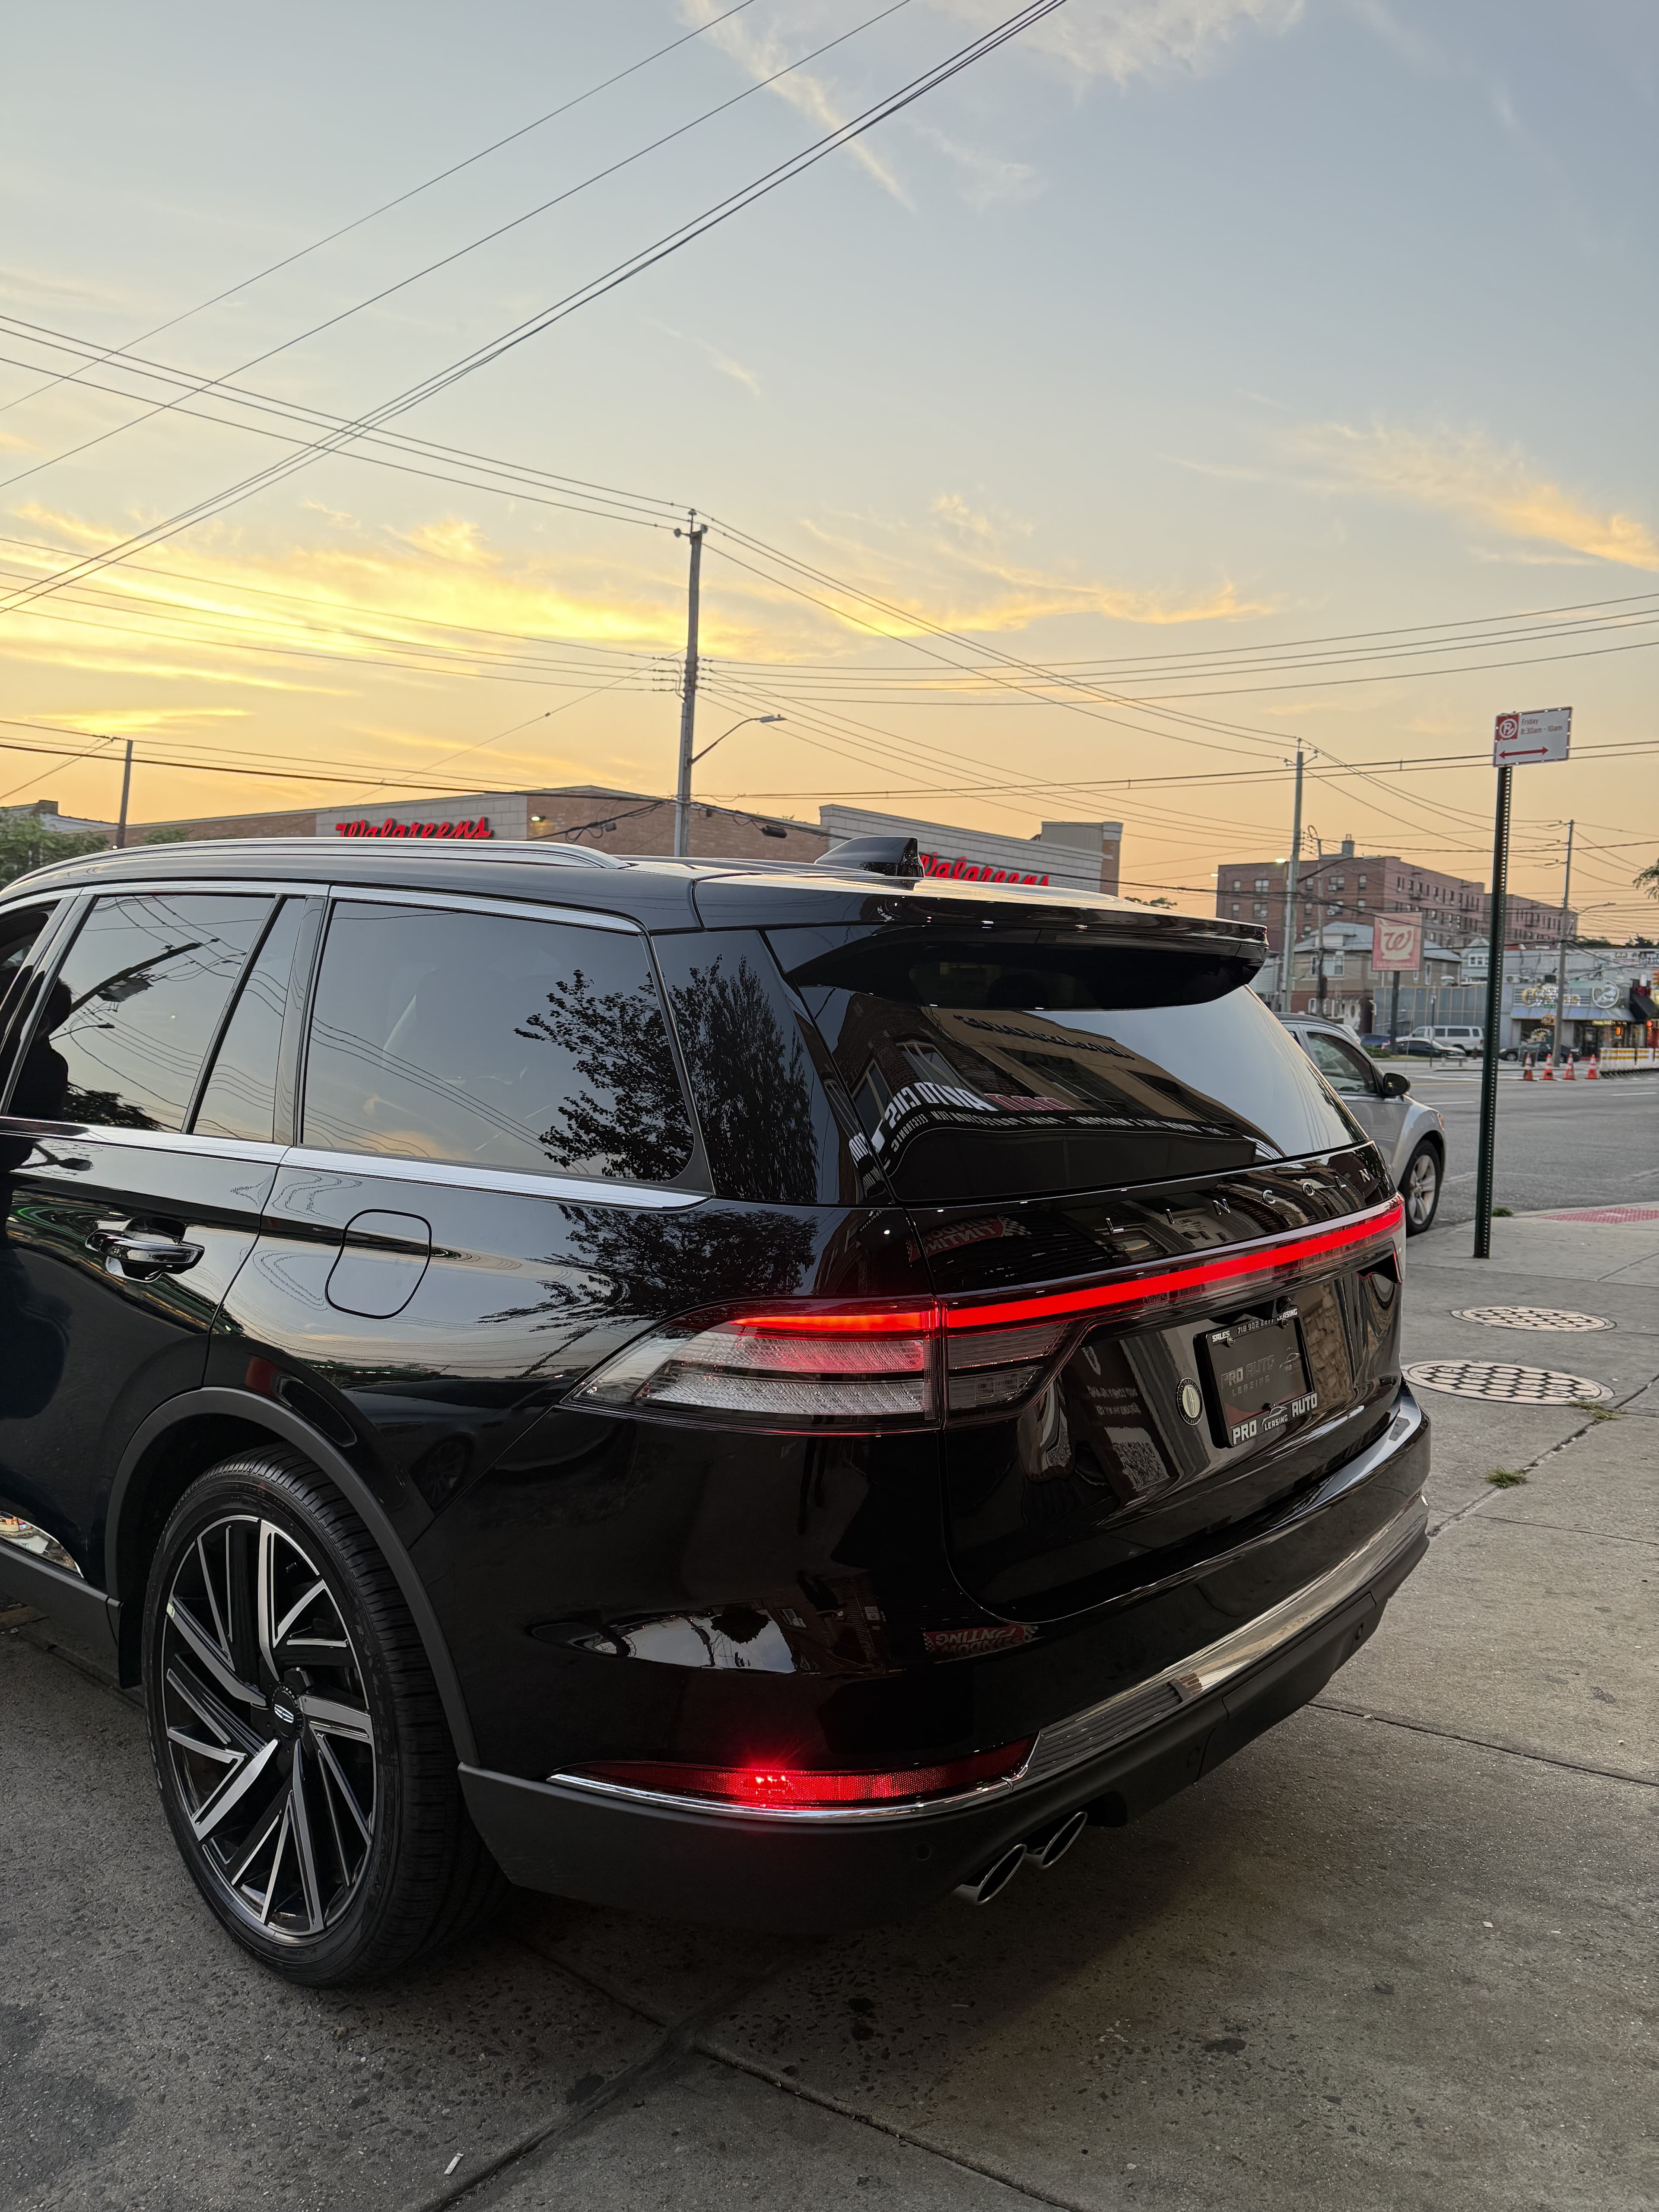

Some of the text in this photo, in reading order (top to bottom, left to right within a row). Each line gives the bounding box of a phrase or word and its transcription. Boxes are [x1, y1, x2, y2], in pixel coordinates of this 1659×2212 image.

[335, 817, 492, 839] Walgreens
[1106, 1169, 1371, 1234] LINCOLN
[1211, 1330, 1230, 1343] SALES
[1237, 1326, 1247, 1335] 718
[1248, 1321, 1259, 1331] 902
[1276, 1308, 1298, 1322] LEASING
[1221, 1367, 1243, 1389] PRO
[1246, 1354, 1274, 1379] AUTO
[1232, 1375, 1270, 1397] LEASING
[1232, 1392, 1318, 1445] PRO AUTO
[1264, 1414, 1288, 1431] LEASING
